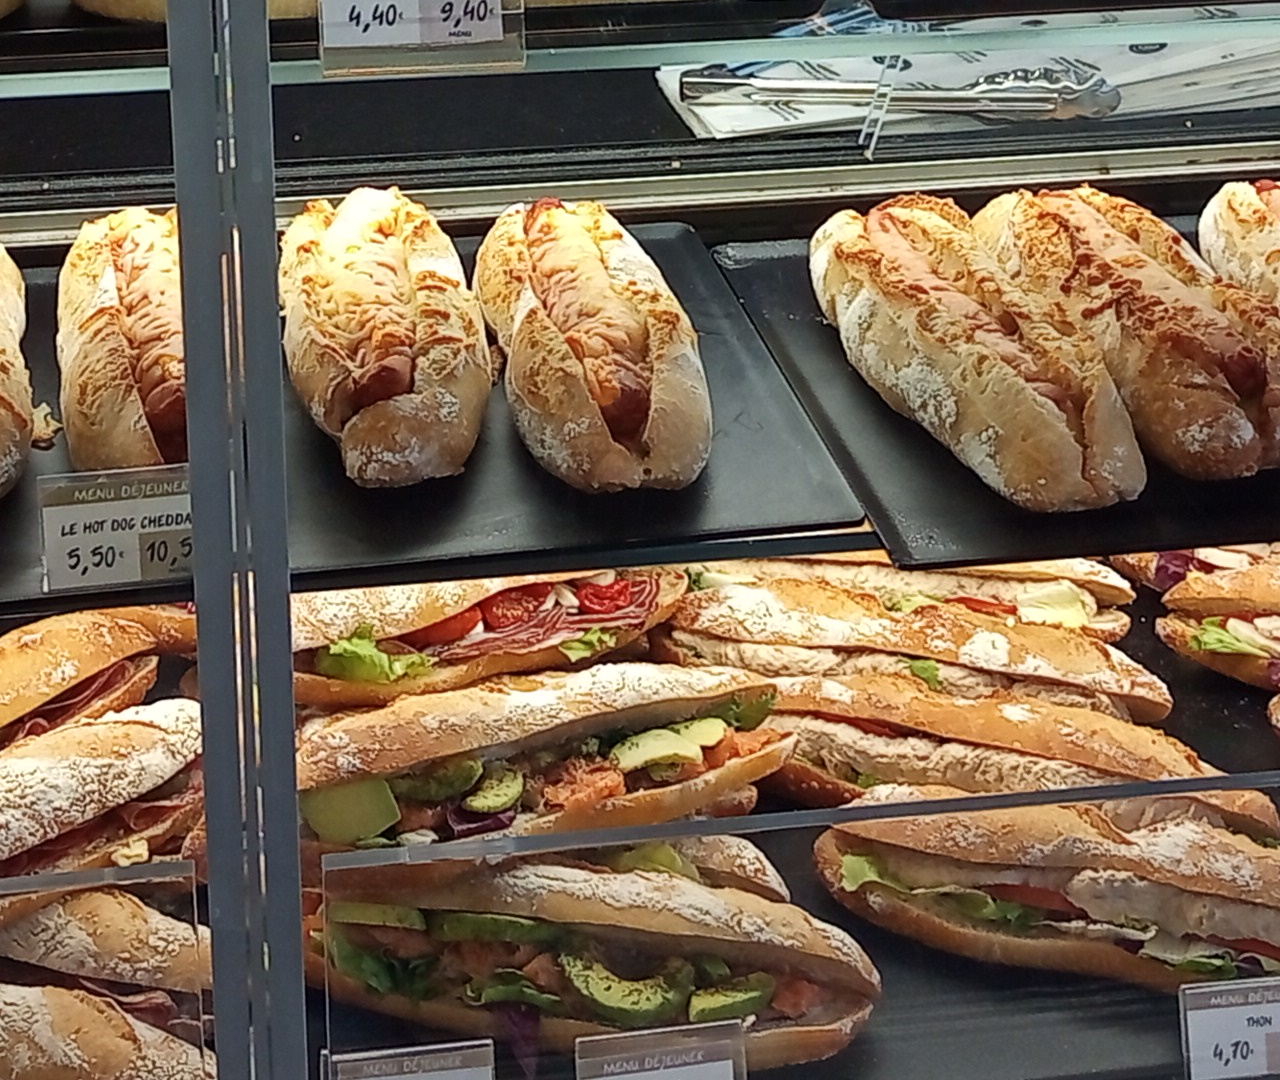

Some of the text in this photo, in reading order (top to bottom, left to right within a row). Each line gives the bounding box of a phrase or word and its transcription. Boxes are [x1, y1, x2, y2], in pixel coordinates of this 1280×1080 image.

[73, 488, 114, 501] MENU
[60, 513, 192, 537] LE HOT DOG CHEDDA
[146, 539, 192, 568] 10,5
[1209, 994, 1245, 1007] MENU
[1246, 1016, 1272, 1028] THON
[363, 1056, 463, 1076] MENU DÉJEUNER
[603, 1050, 705, 1075] MENU DÉJEUNER
